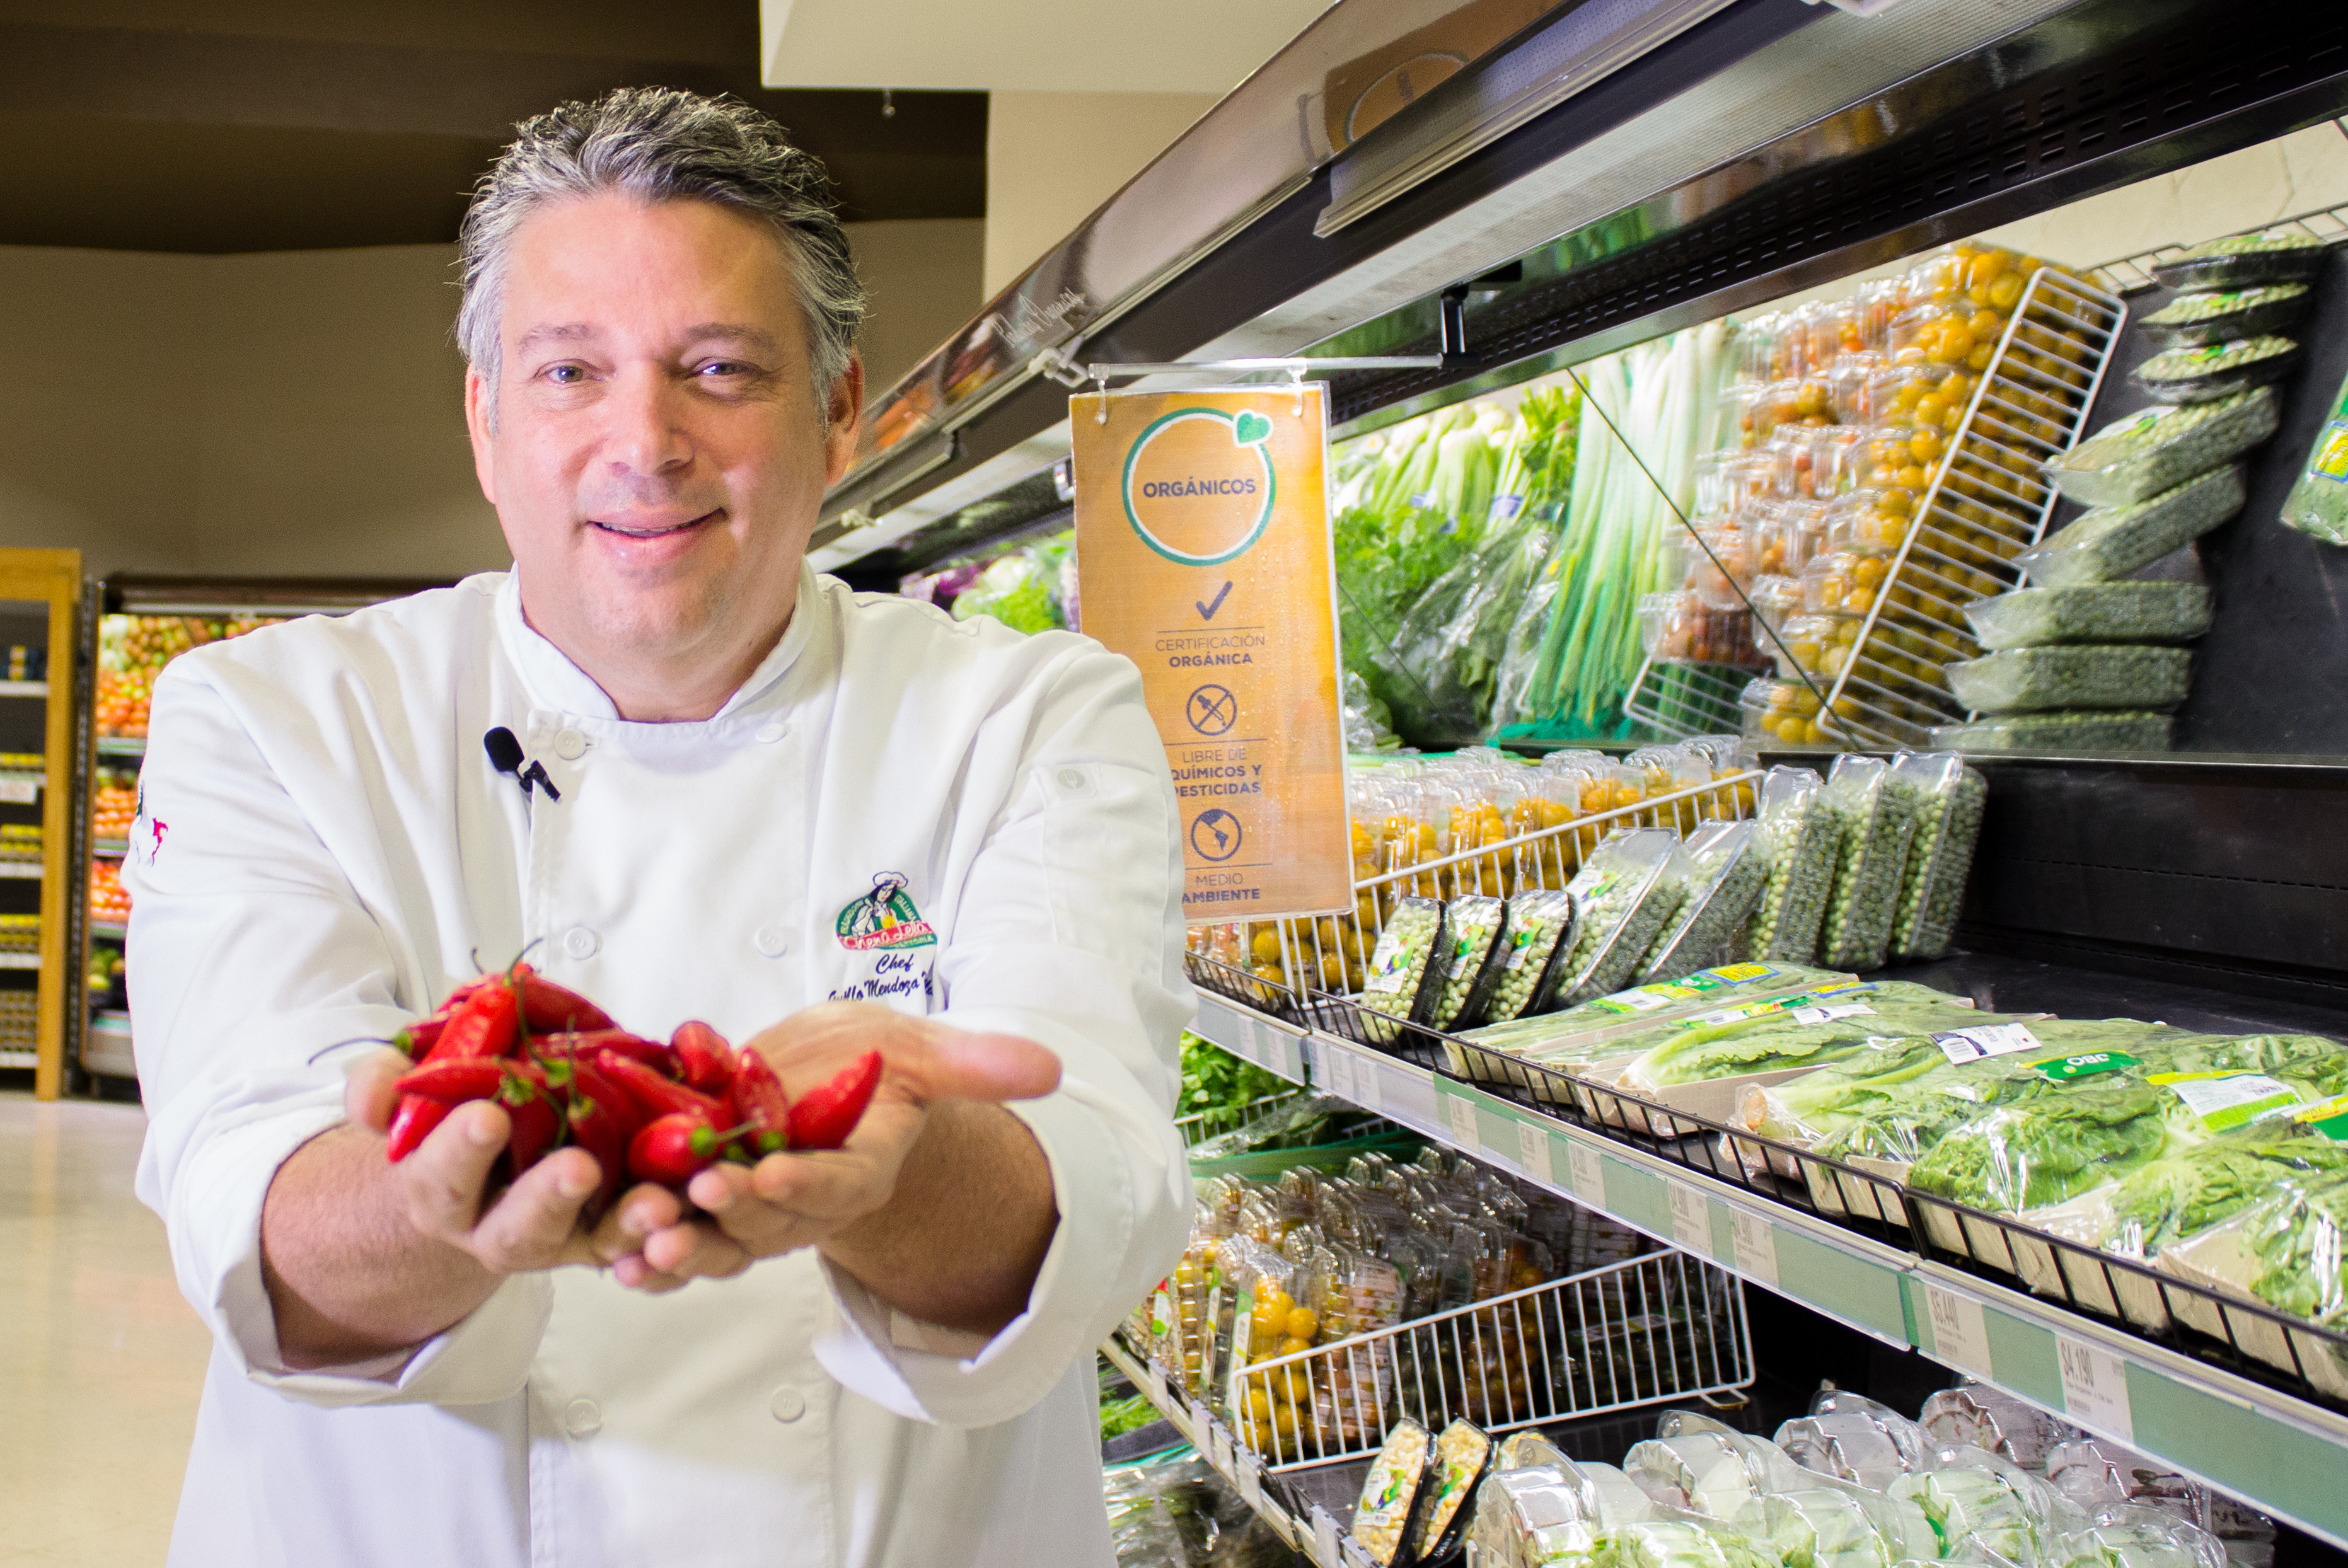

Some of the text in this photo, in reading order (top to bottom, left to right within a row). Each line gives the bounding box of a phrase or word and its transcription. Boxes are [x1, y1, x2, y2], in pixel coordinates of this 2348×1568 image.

[1143, 476, 1256, 498] ORGÁNICOS
[1155, 635, 1266, 652] CERTIFICACIÓN
[1169, 652, 1252, 668] ORGÁNICA
[1183, 748, 1247, 763] LIBRE DE
[1171, 764, 1261, 781] QUÍMICOS Y
[1196, 873, 1244, 886] MEDIO
[1181, 889, 1261, 904] AMBIENTE
[876, 954, 914, 975] Chef
[864, 976, 920, 997] Mendoza
